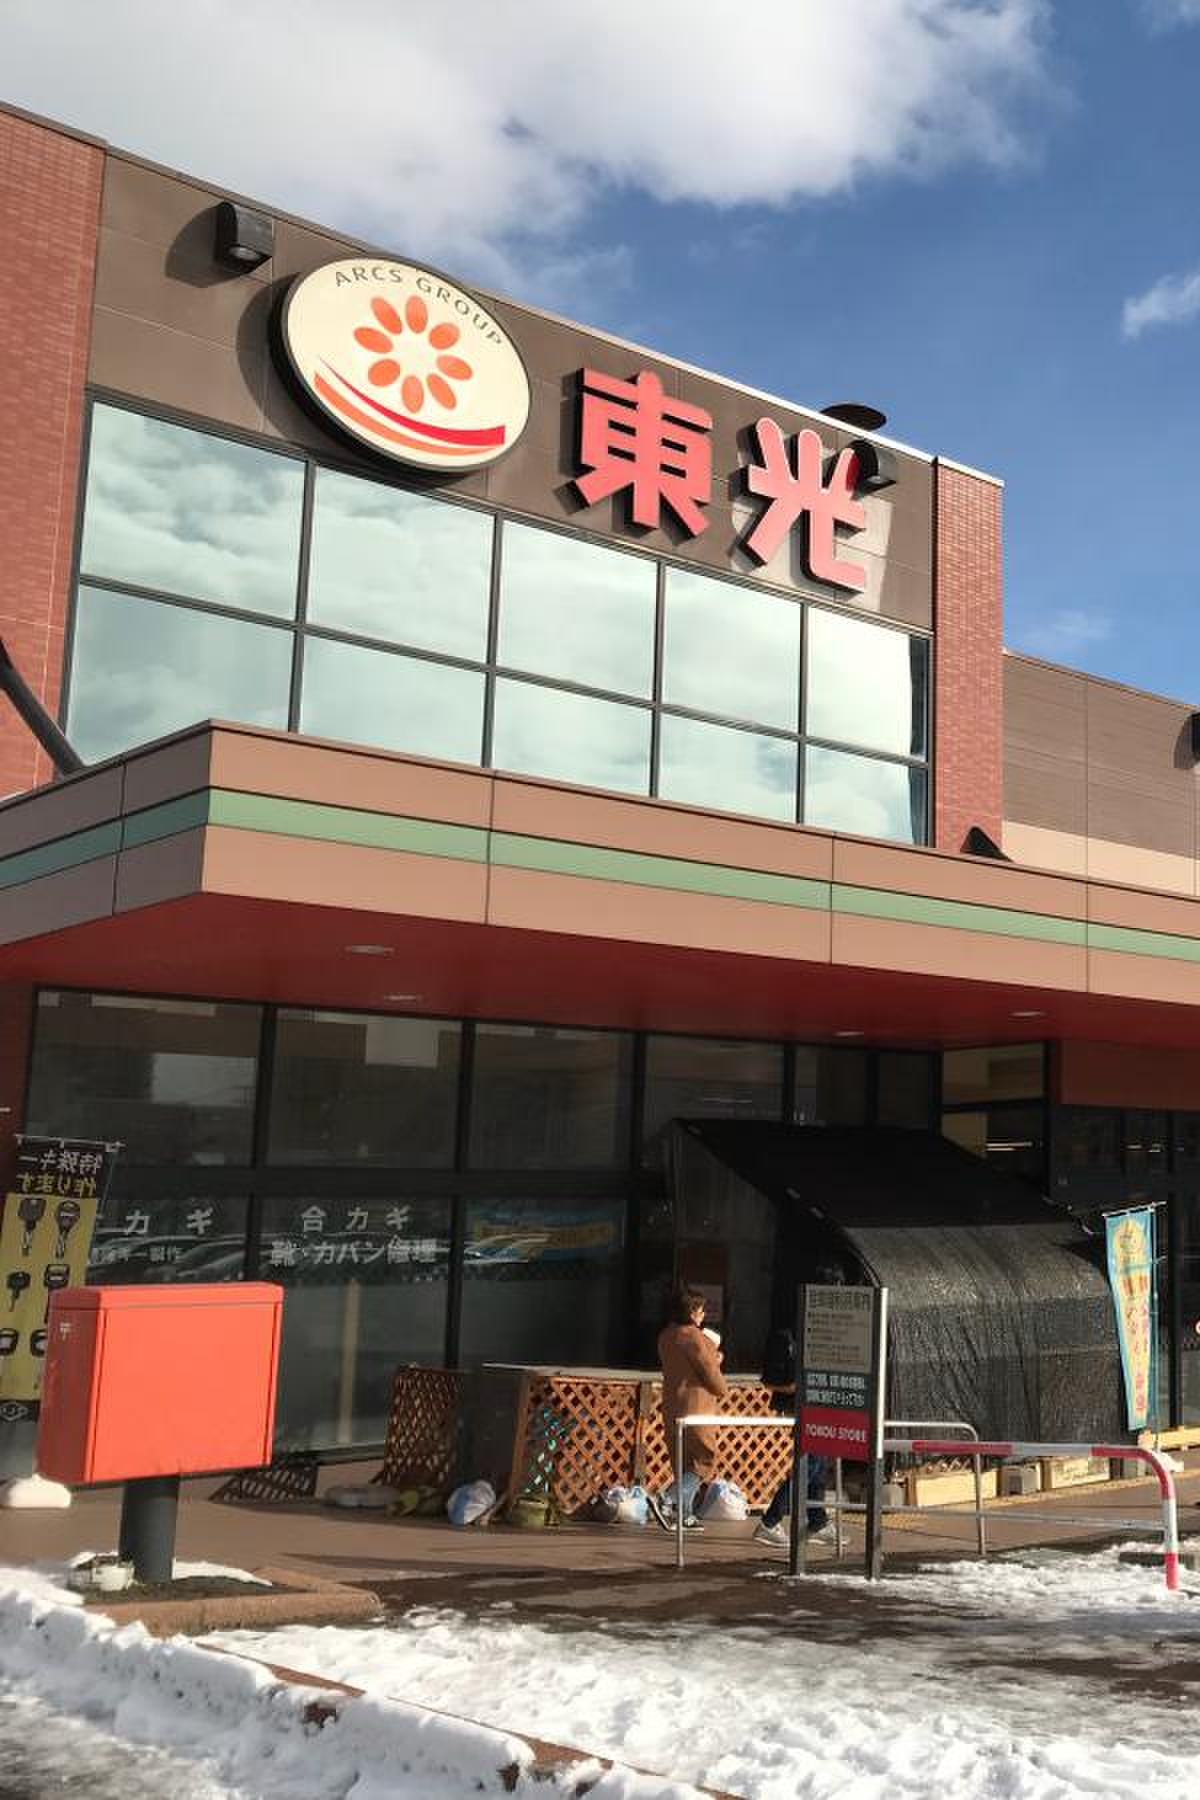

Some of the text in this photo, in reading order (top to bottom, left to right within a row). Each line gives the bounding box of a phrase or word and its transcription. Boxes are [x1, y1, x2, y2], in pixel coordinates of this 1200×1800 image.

[335, 266, 502, 345] ARCS GROUP
[574, 371, 866, 591] 東光
